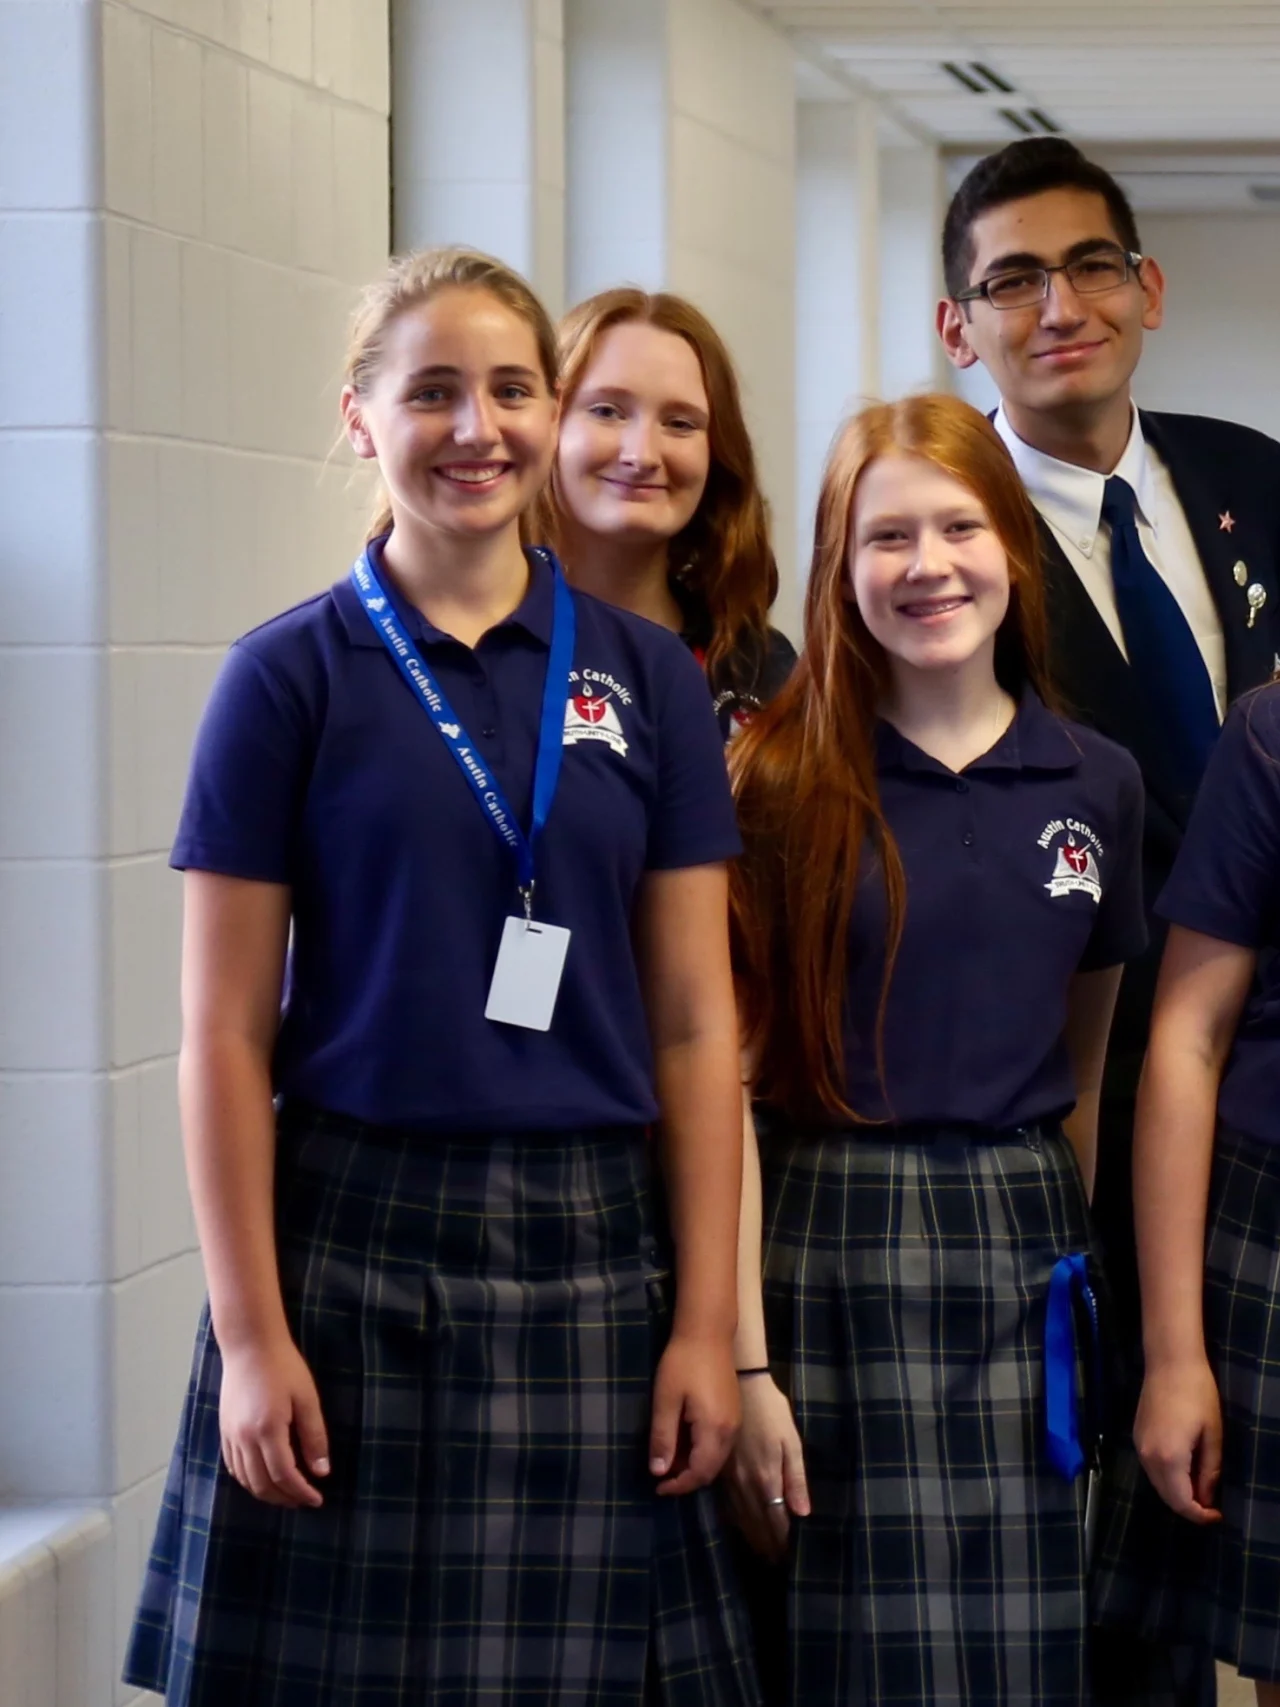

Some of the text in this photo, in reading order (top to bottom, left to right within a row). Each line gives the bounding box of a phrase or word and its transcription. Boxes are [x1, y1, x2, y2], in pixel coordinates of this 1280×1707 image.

[380, 617, 442, 713] Austin Catholic
[583, 669, 632, 705] Catholic
[457, 747, 518, 847] Austin Catholic
[1037, 818, 1104, 857] Austin Catholic
